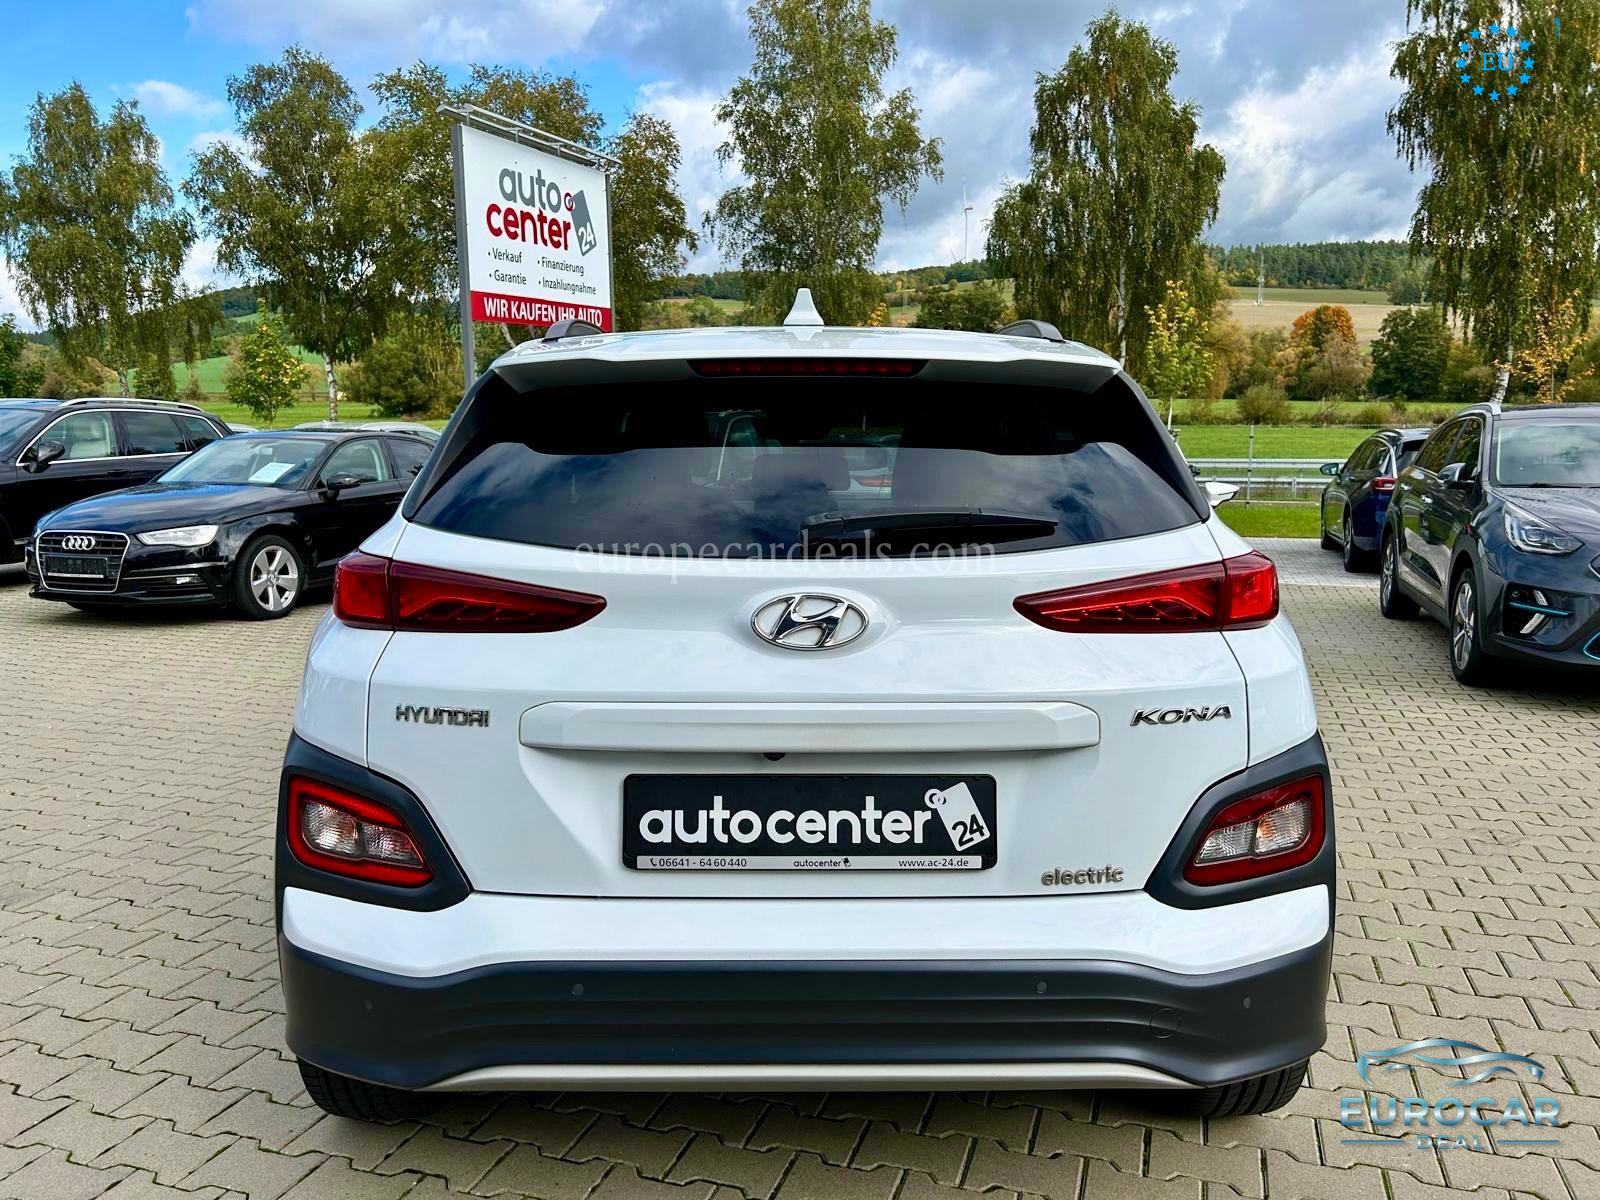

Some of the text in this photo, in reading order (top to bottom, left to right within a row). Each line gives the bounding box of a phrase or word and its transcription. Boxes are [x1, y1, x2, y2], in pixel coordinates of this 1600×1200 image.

[499, 168, 561, 213] auto
[486, 203, 594, 251] center 24
[492, 248, 522, 264] Verkauf
[541, 256, 584, 277] Finanzierung
[494, 269, 527, 286] Garantie
[542, 277, 597, 295] Inzahlungnahme
[483, 296, 509, 318] WIR
[511, 300, 555, 323] KAUFEN
[577, 307, 603, 328] AUTO
[395, 704, 491, 728] HYUNDAI
[1130, 705, 1232, 727] KONA
[638, 795, 985, 847] autocenter 24
[658, 858, 690, 867] 06641
[793, 859, 841, 868] autocenter
[898, 858, 969, 868] www.ac-24.de
[1041, 865, 1124, 886] electric
